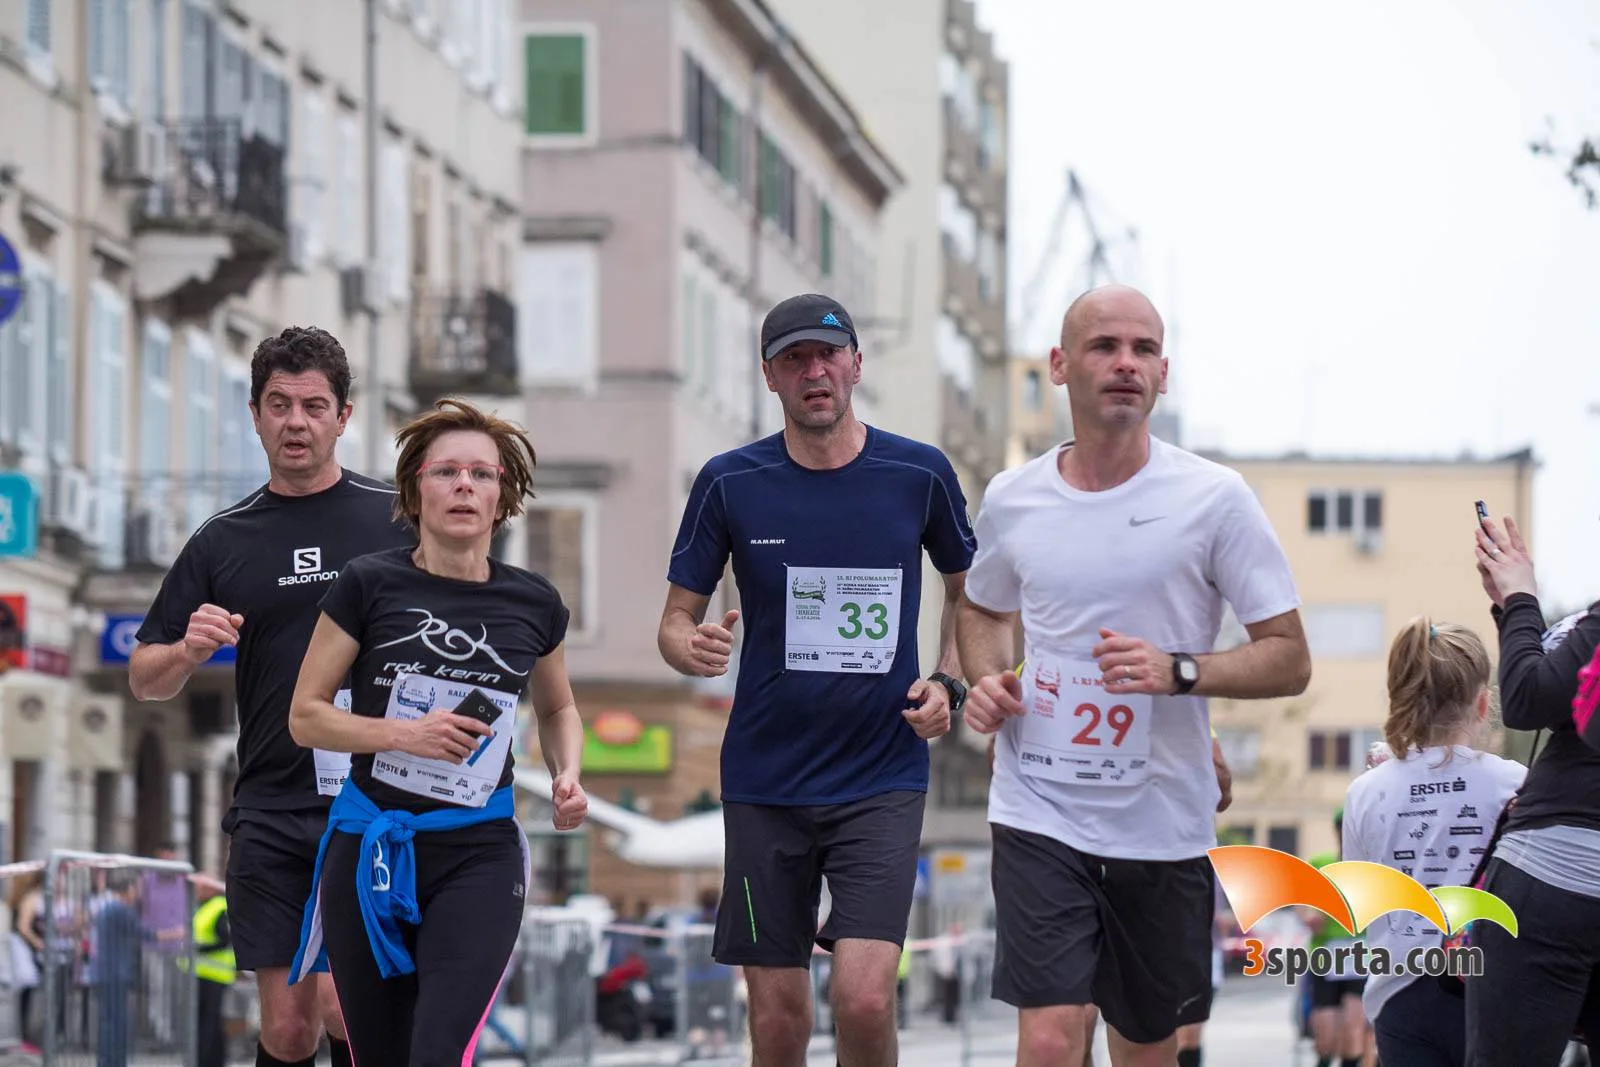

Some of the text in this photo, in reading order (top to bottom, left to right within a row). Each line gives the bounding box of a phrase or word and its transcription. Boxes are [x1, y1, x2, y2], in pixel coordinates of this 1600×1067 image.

[837, 602, 889, 640] 33
[787, 652, 811, 661] ERSTE
[383, 661, 501, 684] rok kerin
[1071, 702, 1135, 748] 29
[376, 760, 399, 776] ERSTE
[319, 777, 338, 785] ERSTE
[1410, 782, 1450, 796] ERSTE
